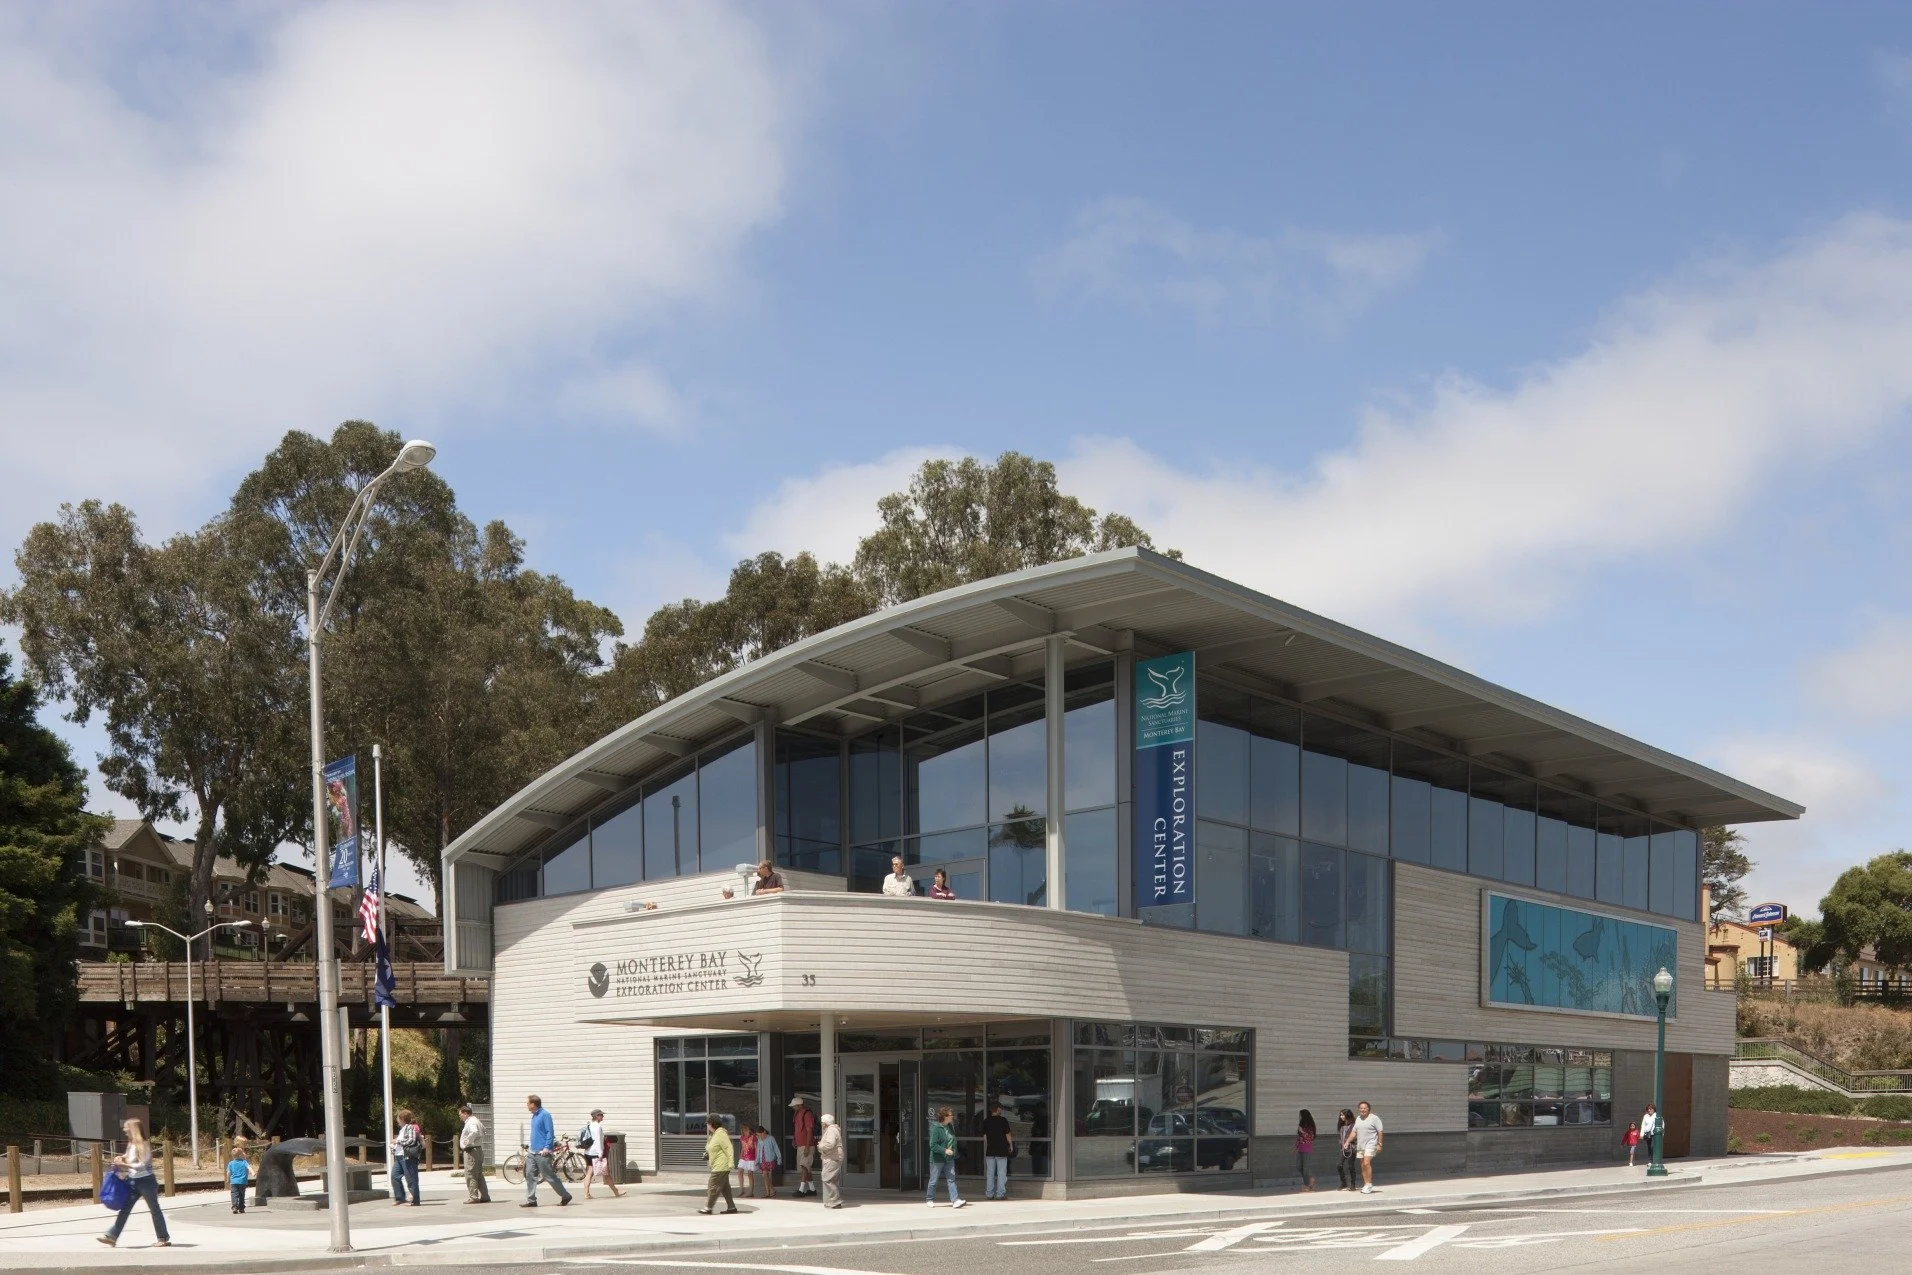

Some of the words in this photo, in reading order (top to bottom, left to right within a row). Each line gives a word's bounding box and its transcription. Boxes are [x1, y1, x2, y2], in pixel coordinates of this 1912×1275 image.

[1141, 713, 1166, 721] NATIONAL
[1143, 729, 1174, 738] MONTEREY
[1173, 749, 1186, 894] EXPLORATION
[1154, 817, 1166, 899] CENTER
[616, 954, 694, 975] MONTEREY
[700, 951, 727, 968] BAY
[616, 975, 650, 984] NATIONAL
[653, 972, 681, 981] MARINE
[684, 969, 727, 979] SANCTUARY
[801, 974, 816, 986] 35
[616, 982, 683, 997] EXPLORATION
[687, 979, 728, 992] CENTER
